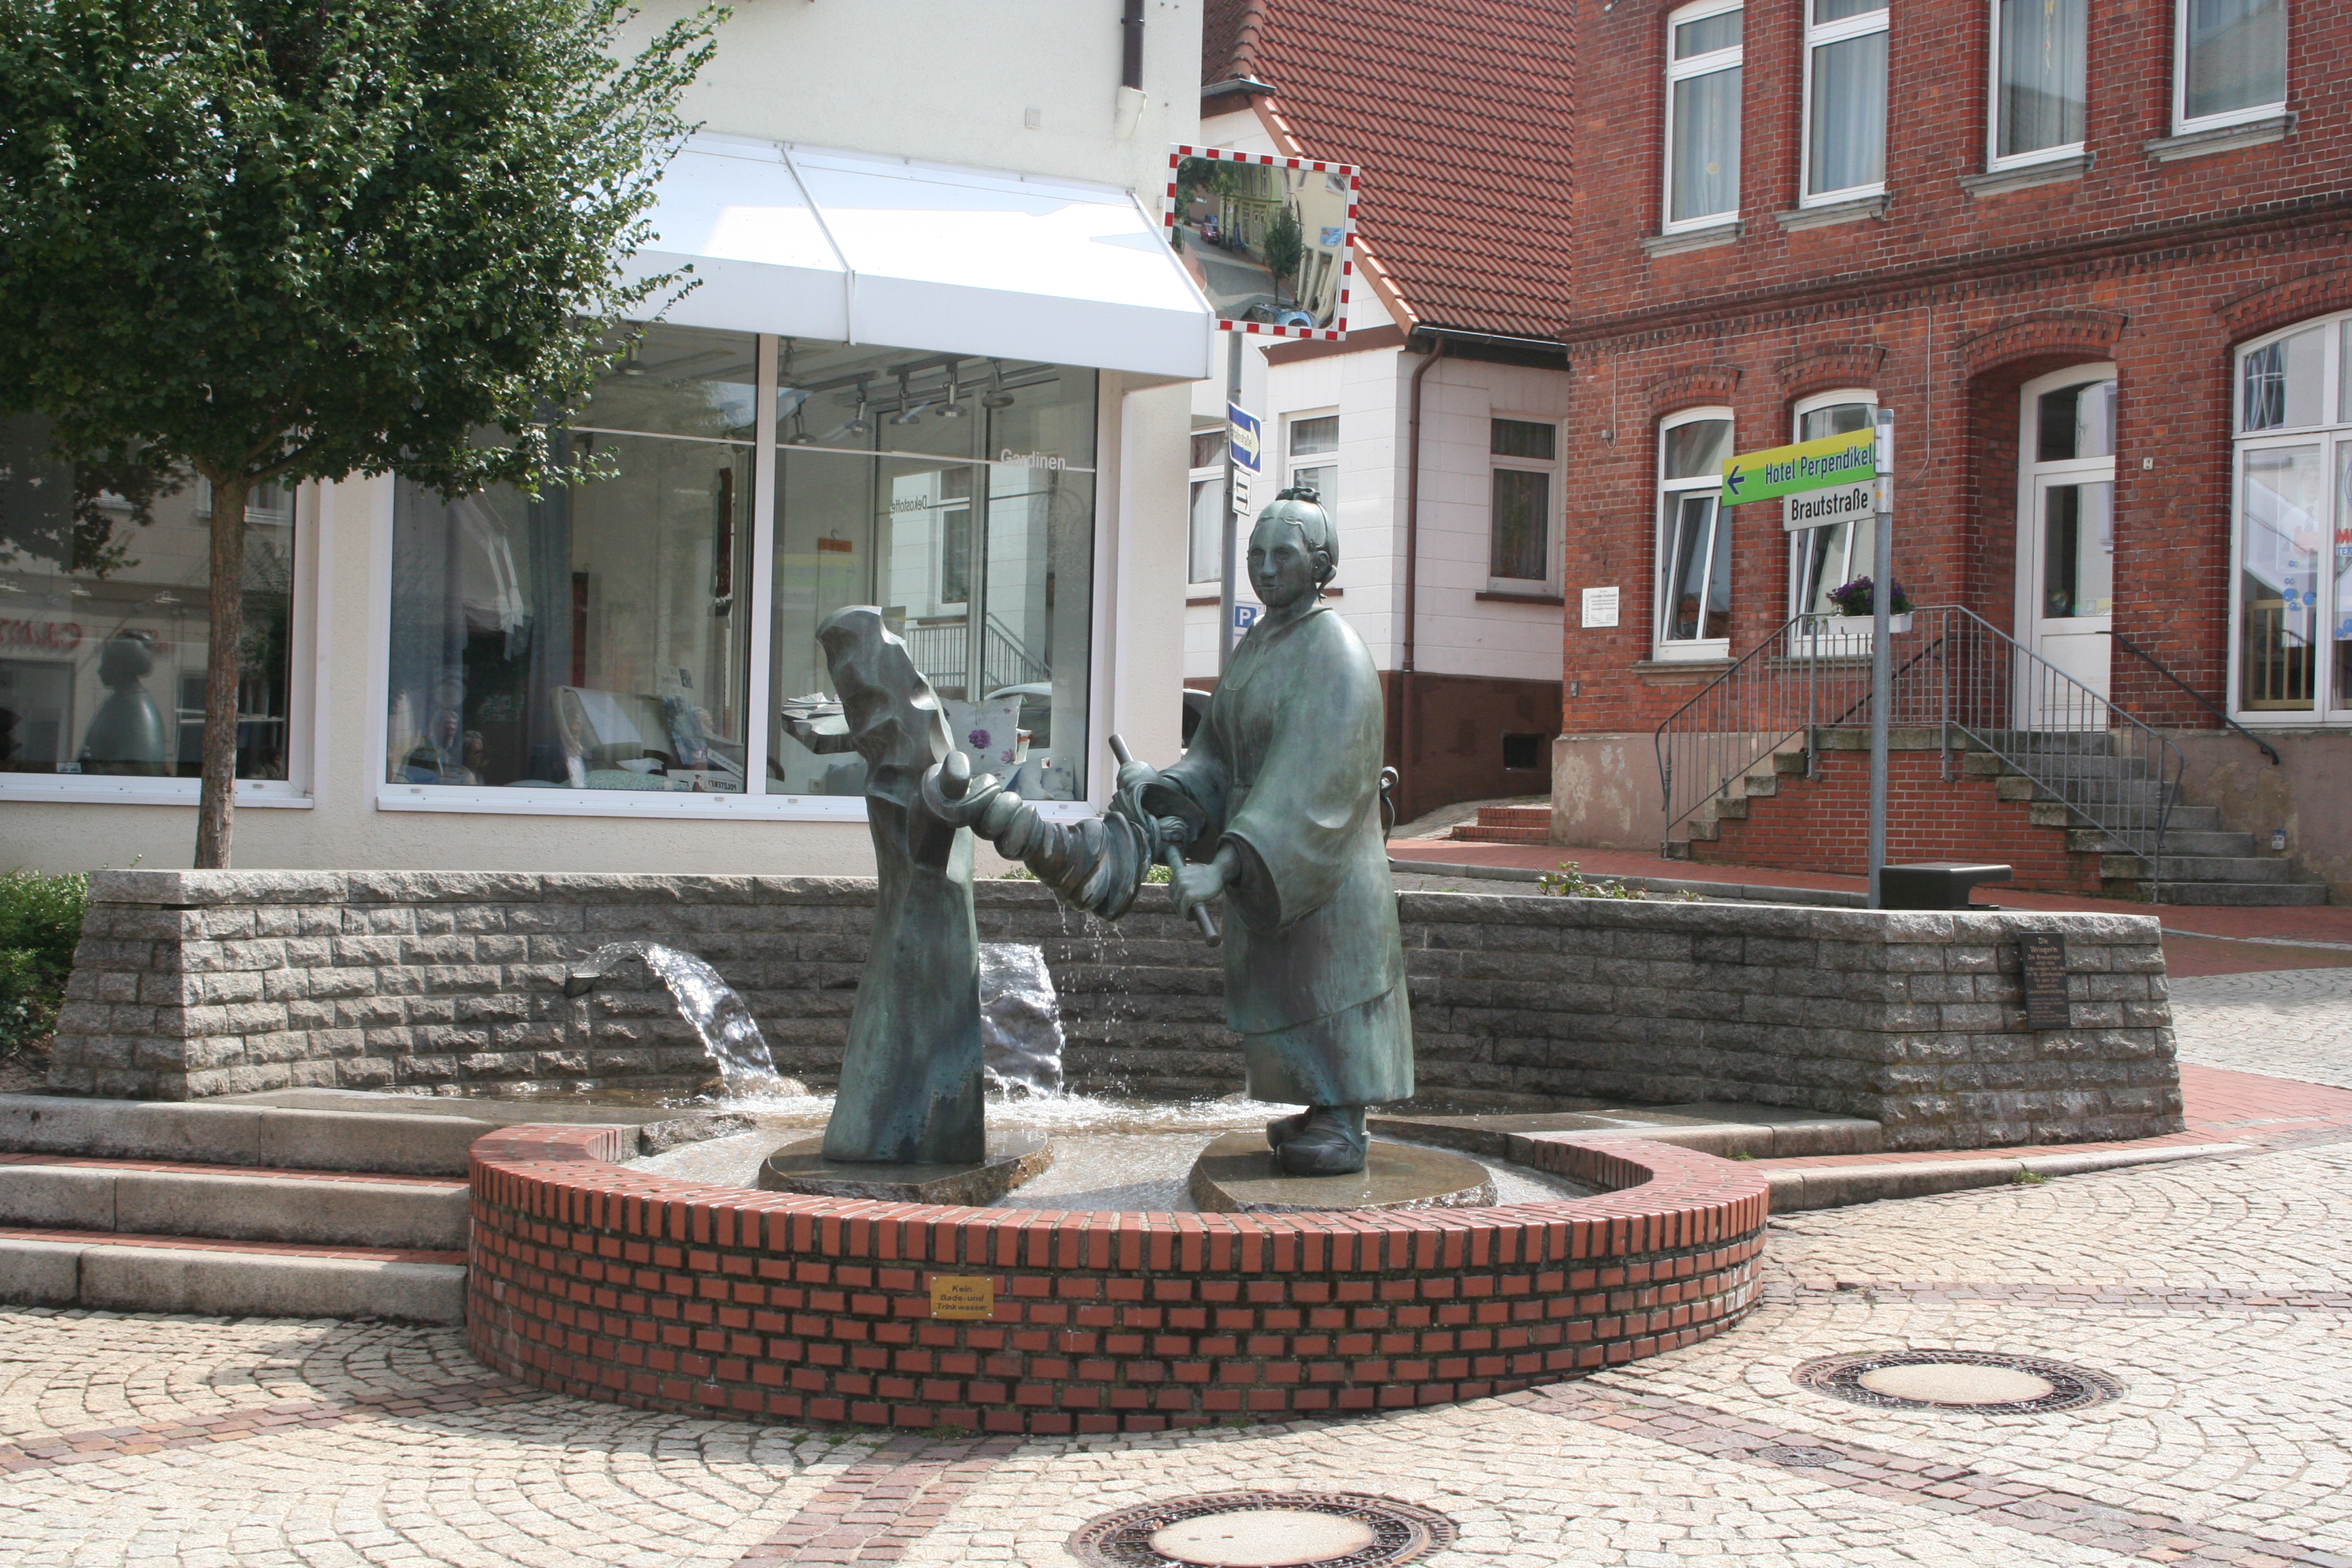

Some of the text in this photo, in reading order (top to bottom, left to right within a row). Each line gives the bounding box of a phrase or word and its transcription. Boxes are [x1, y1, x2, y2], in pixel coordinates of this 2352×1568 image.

[1000, 448, 1066, 470] Gardinen
[1765, 442, 1872, 485] Hotel Perpendikel
[1791, 488, 1868, 521] Brautstraße
[1239, 608, 1252, 625] P
